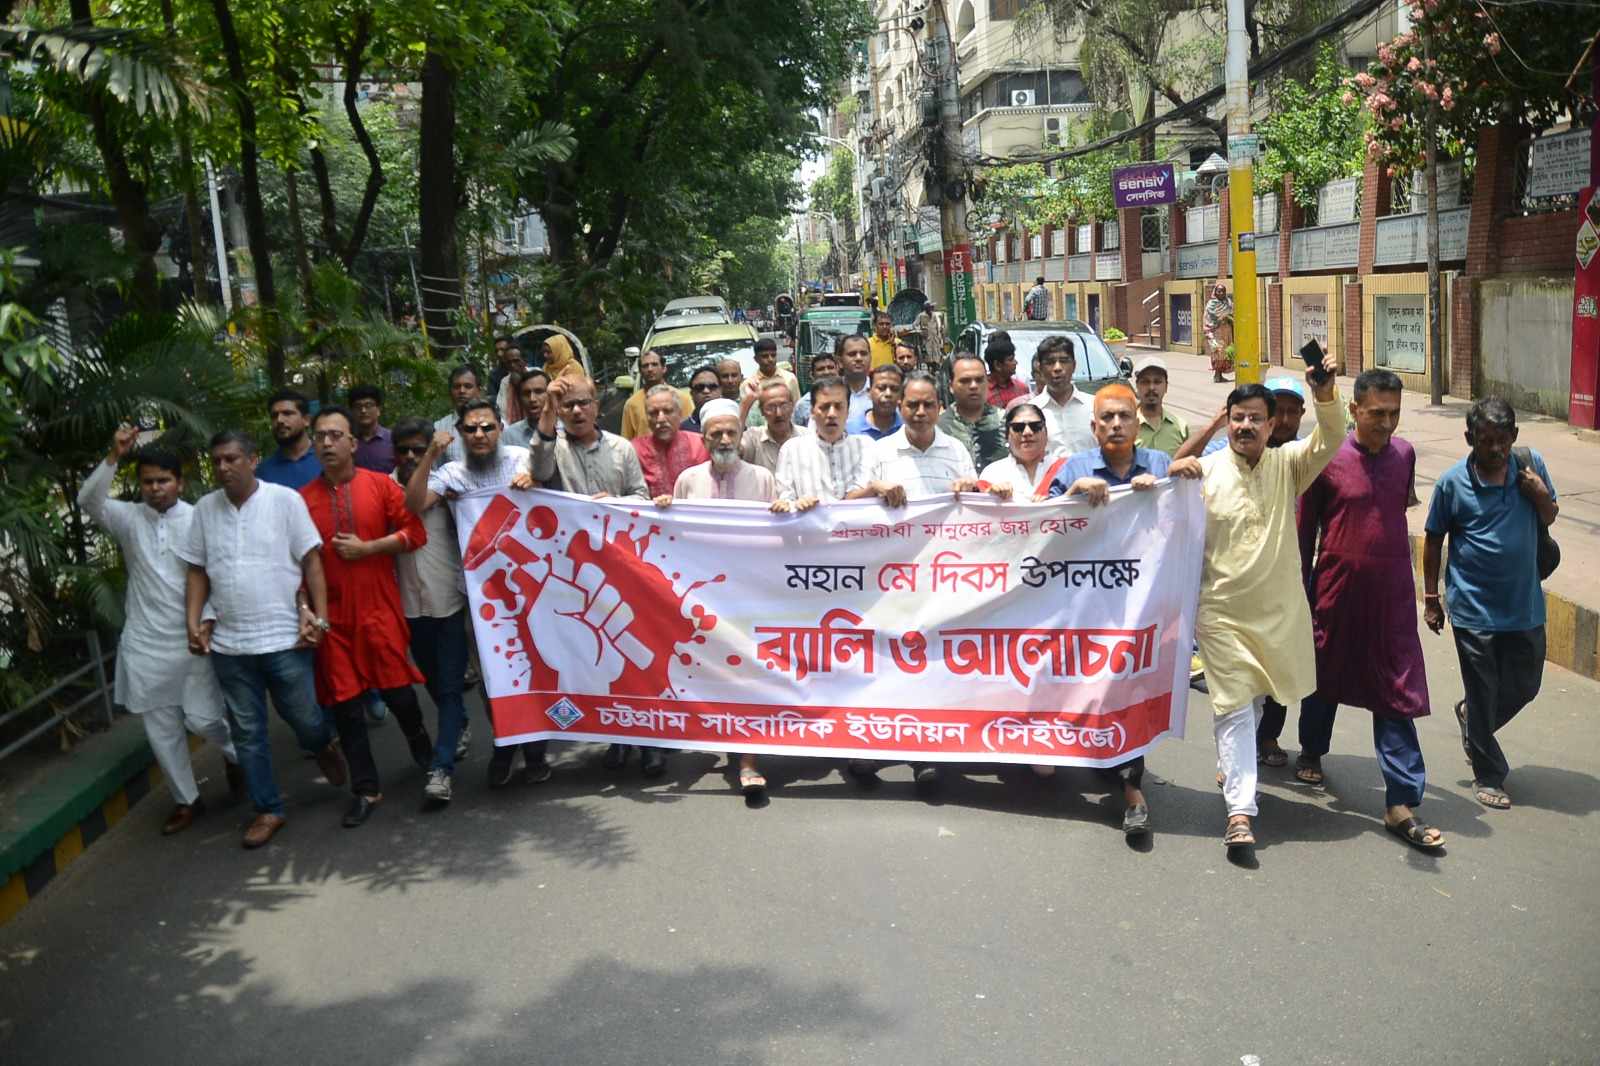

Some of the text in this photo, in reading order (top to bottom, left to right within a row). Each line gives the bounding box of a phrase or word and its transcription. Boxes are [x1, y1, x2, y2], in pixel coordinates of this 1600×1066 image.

[954, 254, 967, 301] NEROLAC
[922, 522, 992, 541] মানুষের
[1000, 520, 1031, 536] জয়
[1039, 517, 1089, 537] হোক
[785, 551, 1141, 593] মহান মে দিবস উপলক্ষে
[889, 630, 928, 673] ও
[938, 623, 1158, 689] আলোচনা
[596, 702, 1127, 752] চট্টগ্রাম সাংবাদিক ইউনিয়ন (সিইউজে)
